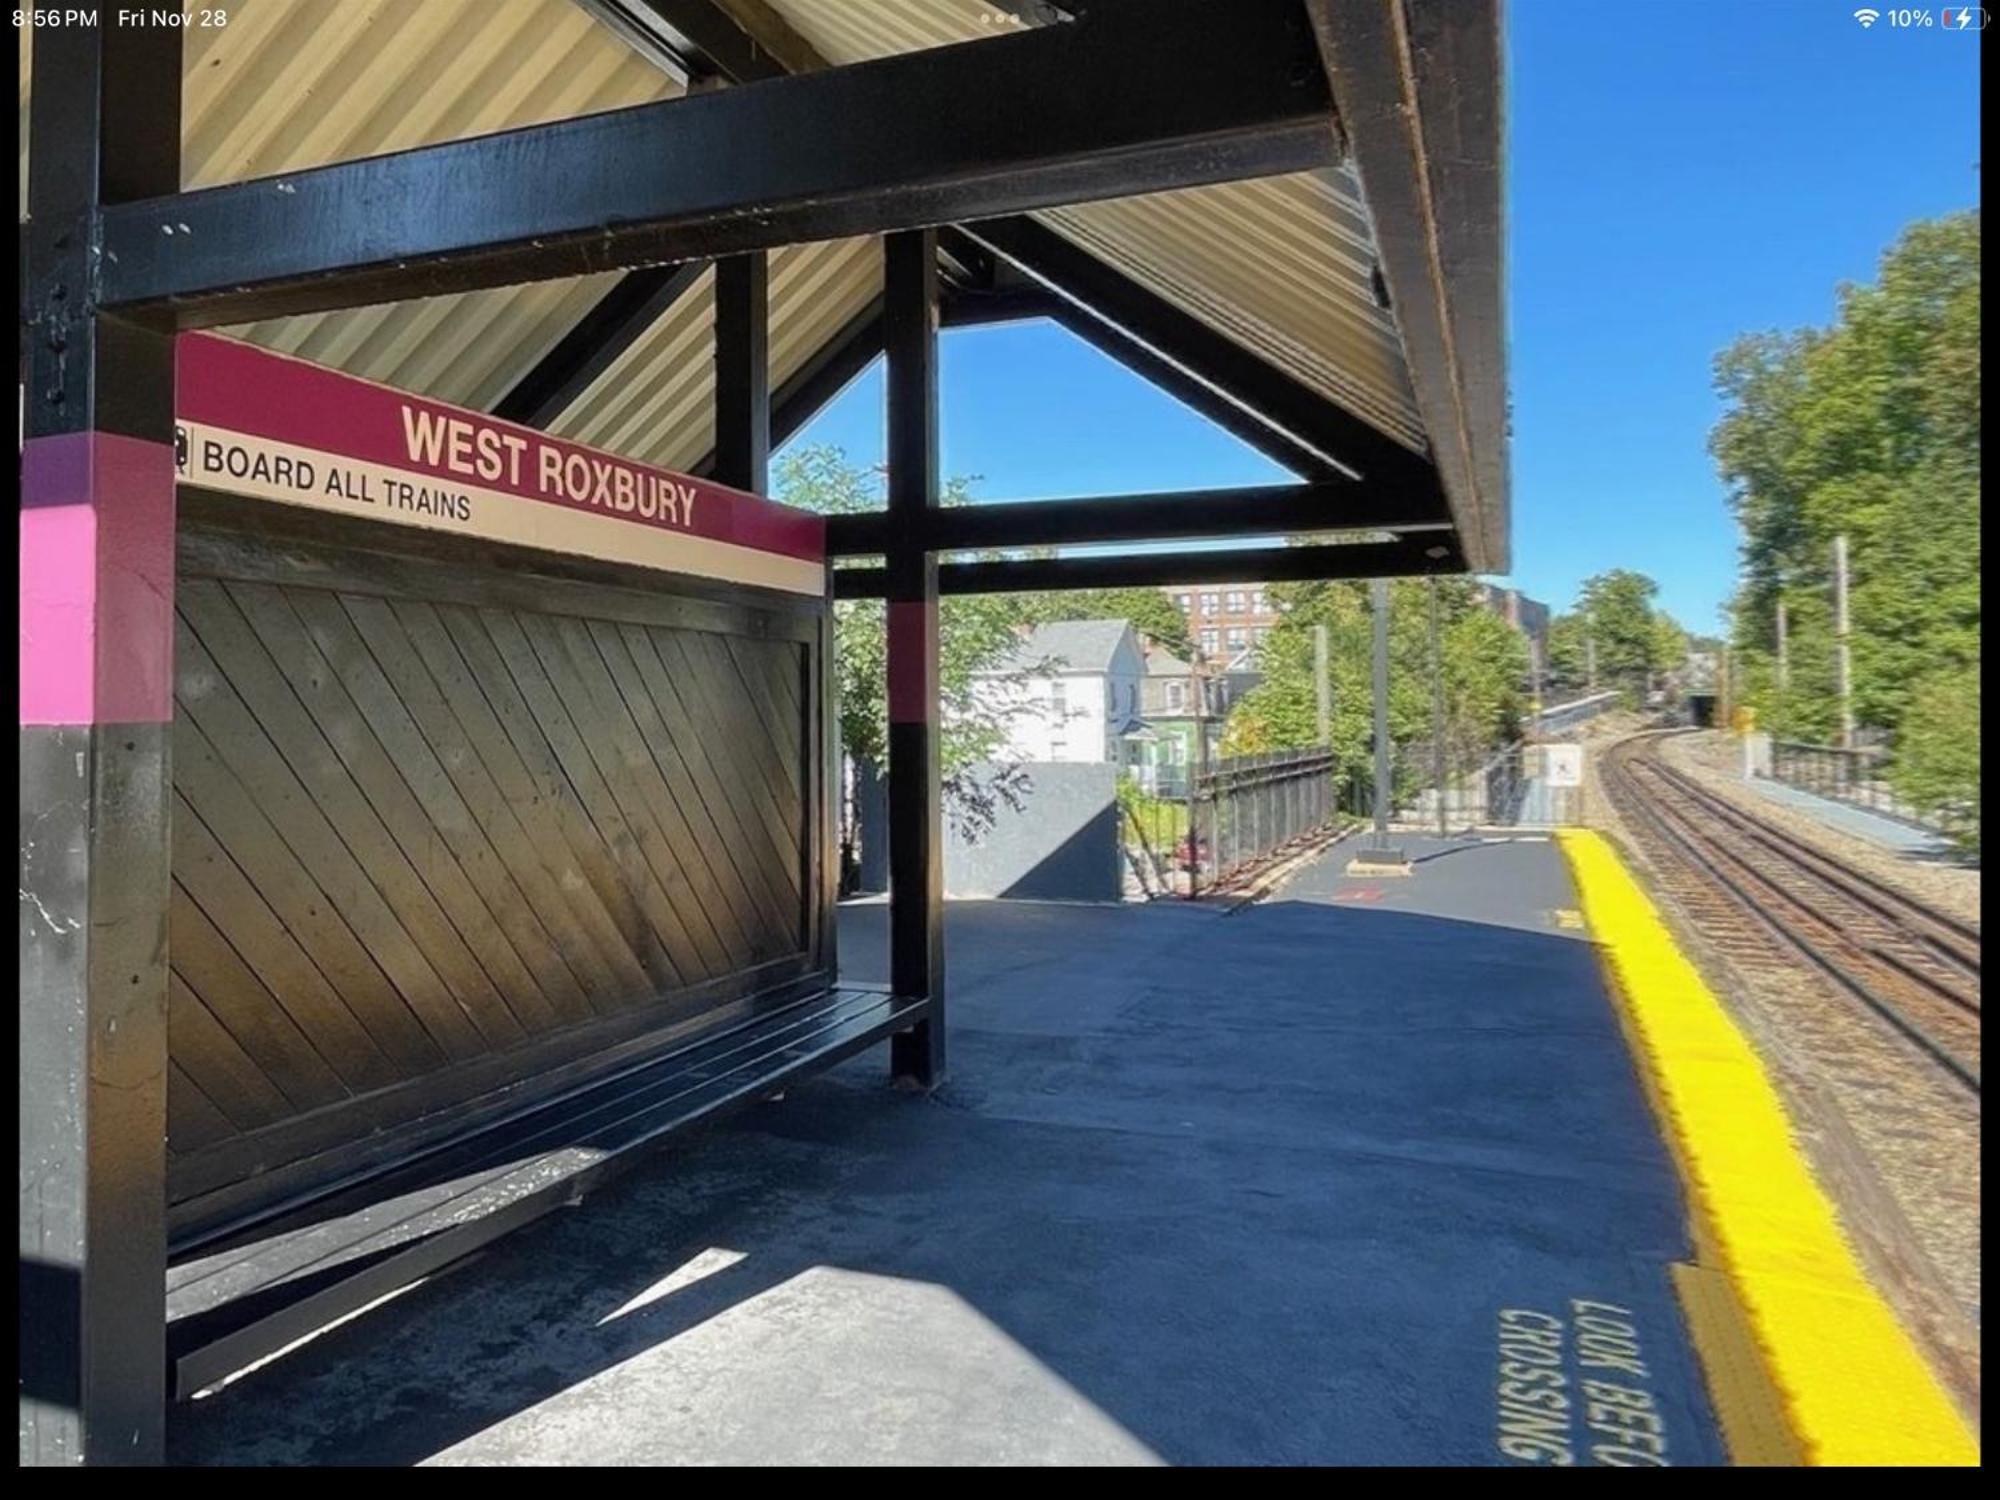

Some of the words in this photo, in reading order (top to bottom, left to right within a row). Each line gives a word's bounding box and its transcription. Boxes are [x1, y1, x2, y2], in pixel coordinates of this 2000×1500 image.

[203, 440, 316, 490] BOARD
[325, 468, 375, 503] ALL
[383, 479, 471, 521] TRAINS
[402, 405, 527, 486] WEST
[539, 446, 697, 527] ROXBURY
[1499, 1309, 1574, 1466] CROSSING
[1572, 1299, 1650, 1377] LOOK
